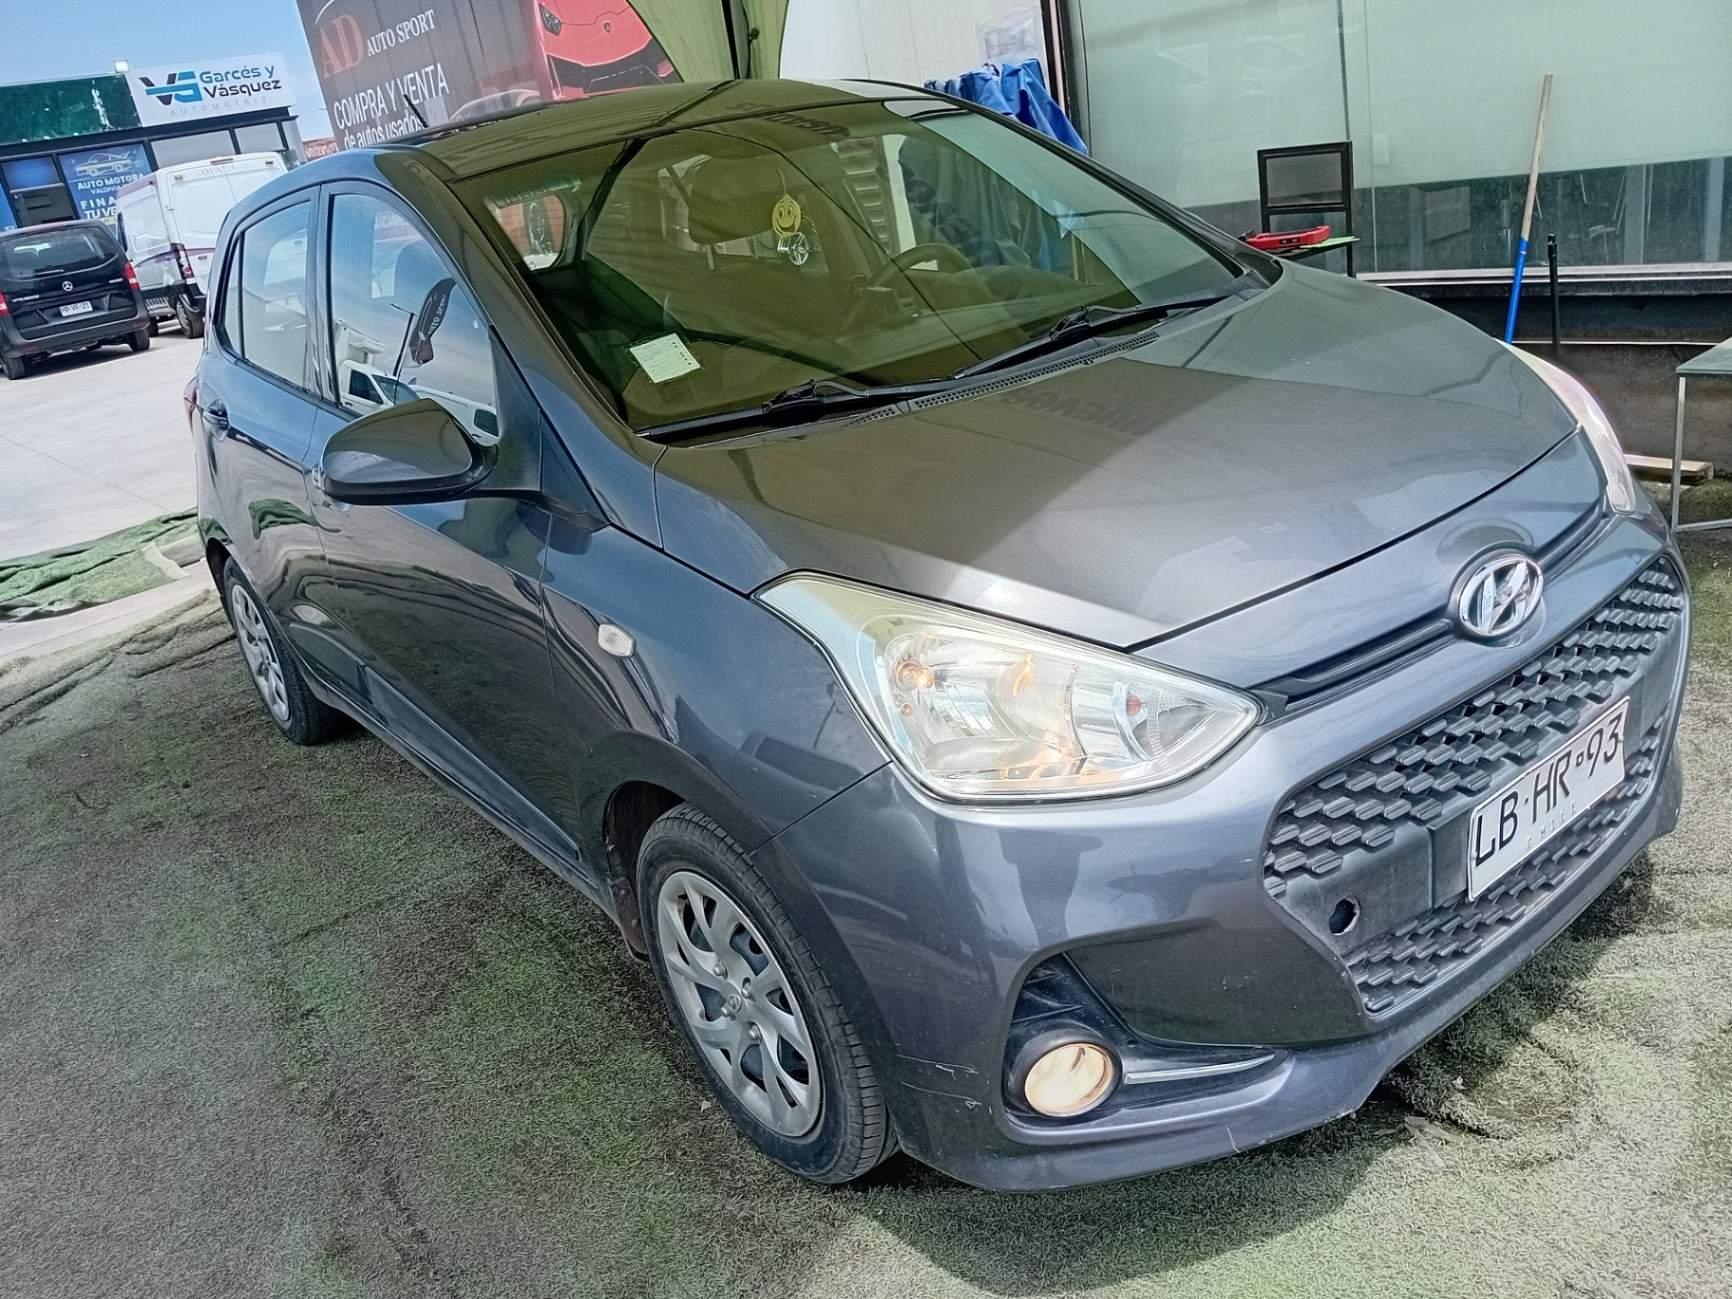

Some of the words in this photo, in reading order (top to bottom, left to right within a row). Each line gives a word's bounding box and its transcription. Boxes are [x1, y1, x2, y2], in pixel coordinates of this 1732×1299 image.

[367, 28, 396, 56] AUTO
[396, 9, 436, 43] SPORT
[319, 14, 364, 79] AD
[199, 65, 261, 84] Garcés
[264, 64, 275, 79] y
[203, 79, 282, 99] Vásquez
[333, 86, 388, 130] COMPRA
[386, 79, 398, 112] Y
[396, 62, 450, 108] VENTA
[344, 129, 356, 148] de
[357, 127, 386, 146] autos
[77, 180, 104, 191] AUTO
[80, 196, 117, 210] FINA
[84, 208, 100, 220] TU
[101, 206, 118, 217] VE
